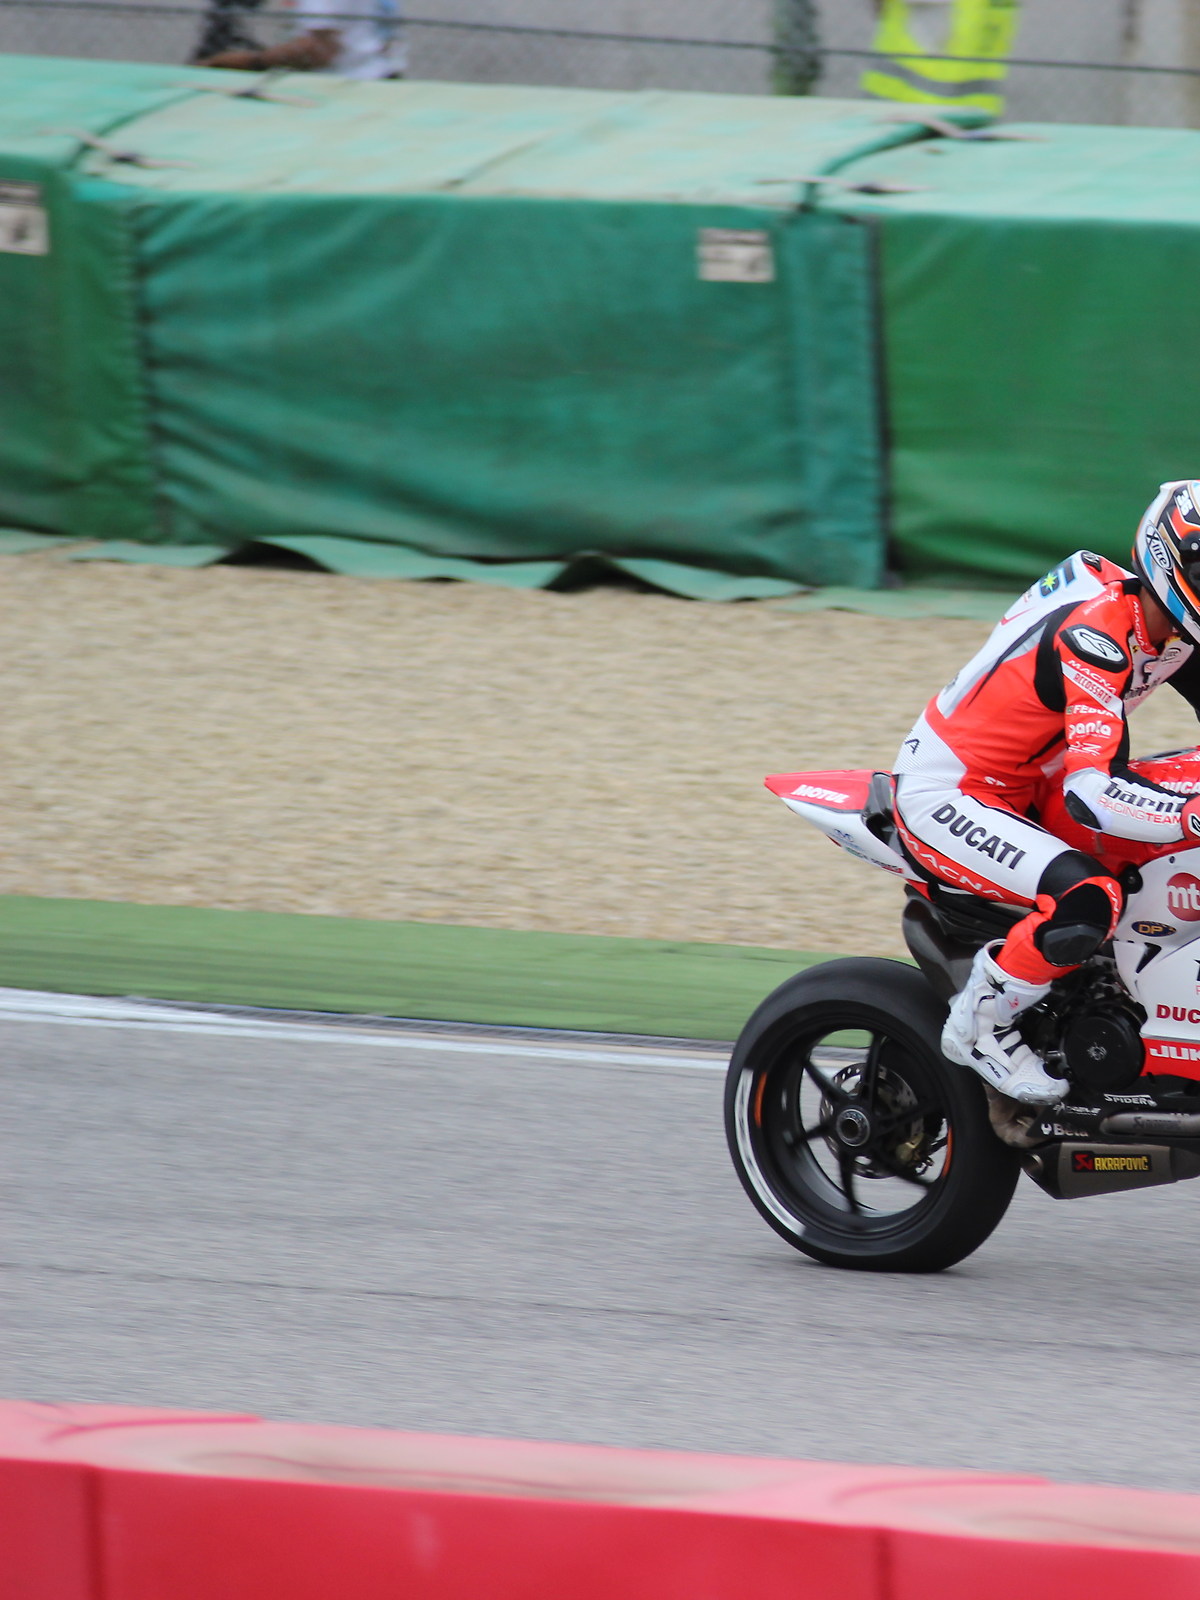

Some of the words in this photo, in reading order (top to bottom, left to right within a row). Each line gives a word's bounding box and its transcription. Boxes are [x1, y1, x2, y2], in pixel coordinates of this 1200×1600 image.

[790, 784, 850, 803] MOTUL
[899, 827, 1005, 899] MACNA
[931, 803, 1027, 870] DUCATI
